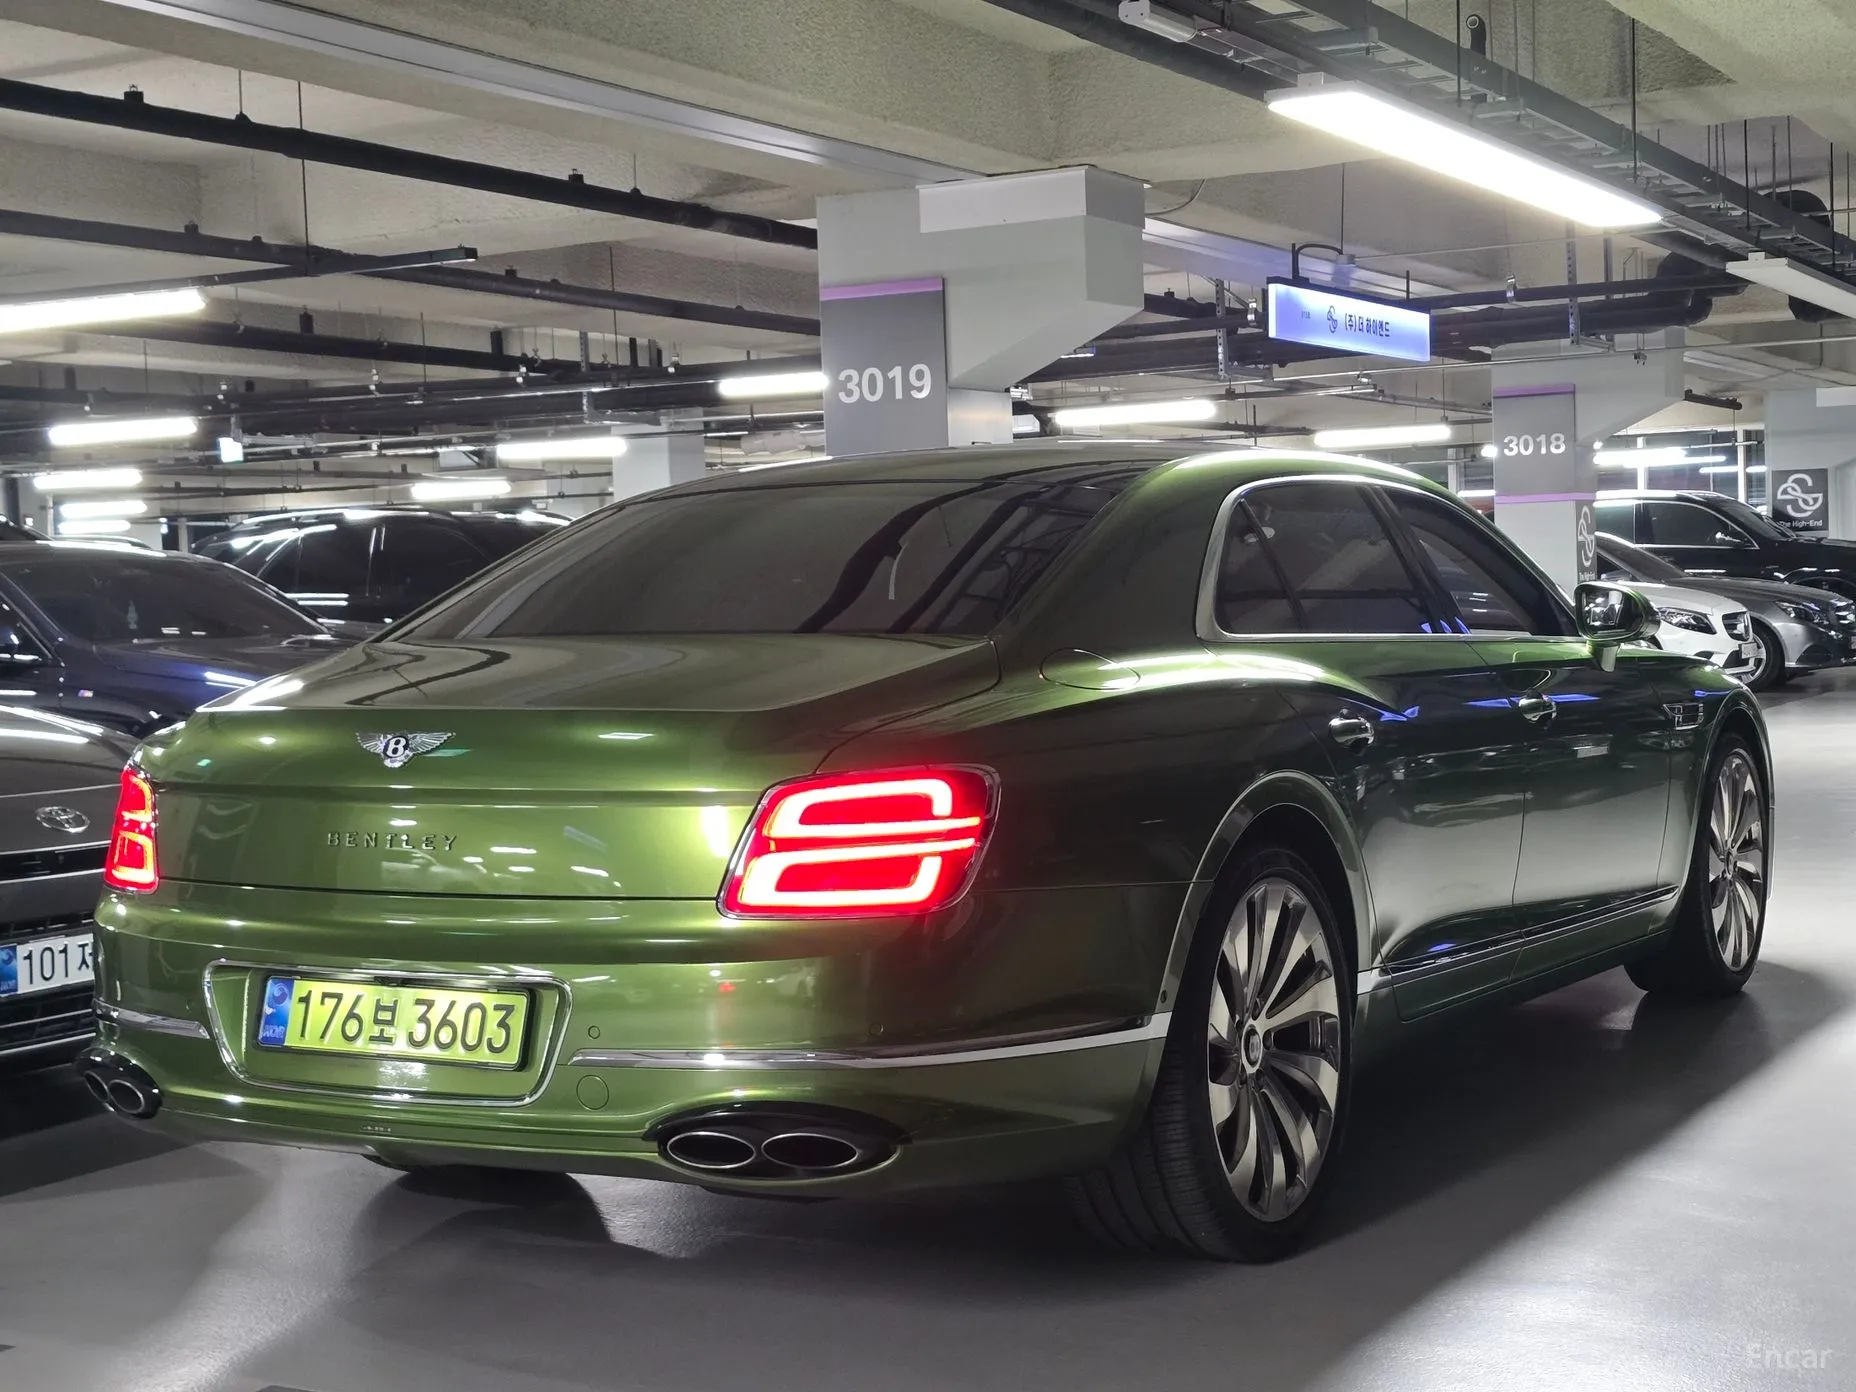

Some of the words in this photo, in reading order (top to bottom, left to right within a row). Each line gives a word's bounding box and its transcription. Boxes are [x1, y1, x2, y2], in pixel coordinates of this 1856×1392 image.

[838, 363, 932, 404] 3019
[1503, 433, 1566, 456] 3018
[1792, 520, 1823, 528] High-End
[327, 831, 457, 851] BENTLEY
